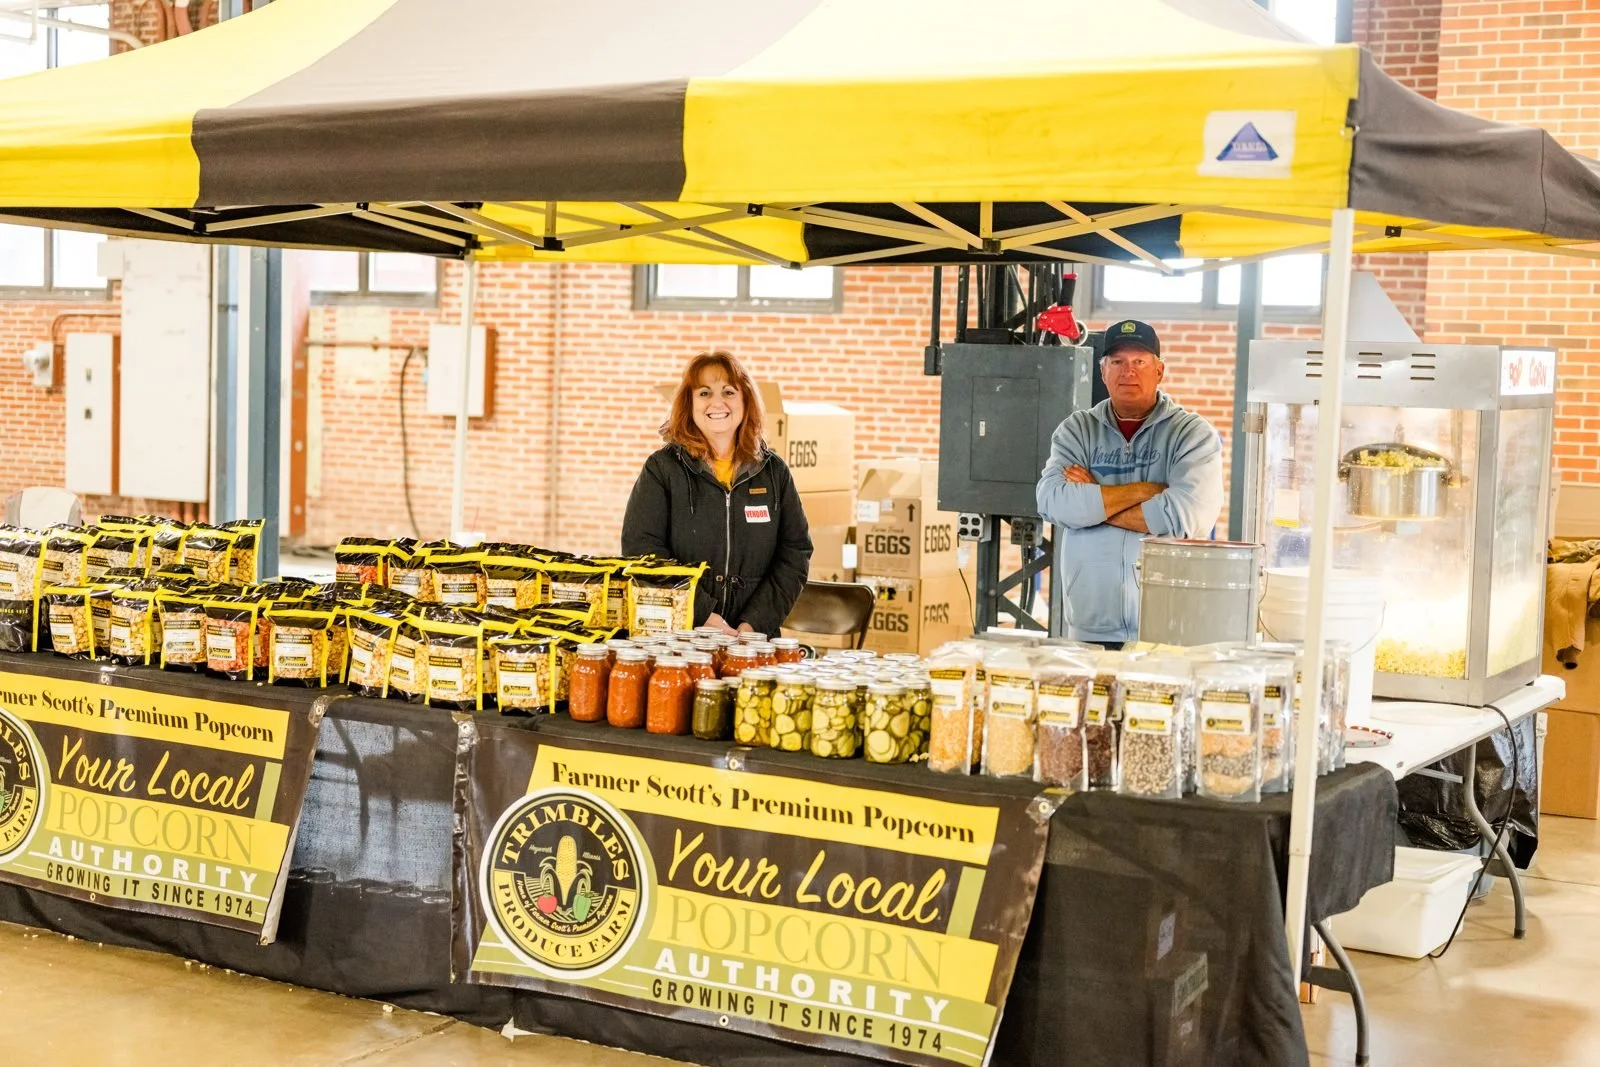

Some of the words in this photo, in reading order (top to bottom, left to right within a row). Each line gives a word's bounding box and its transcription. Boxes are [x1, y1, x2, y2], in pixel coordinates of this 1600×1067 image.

[789, 440, 818, 468] EGGS
[745, 510, 768, 518] VENDOR
[865, 534, 911, 556] EGGS
[924, 524, 952, 554] EGGS
[868, 612, 909, 633] GGS
[42, 689, 94, 716] Scott's
[99, 698, 188, 731] Premium
[194, 712, 274, 744] Popcorn
[58, 735, 136, 793] Your
[147, 750, 256, 810] Local
[552, 762, 642, 796] Farmer
[646, 780, 723, 809] Scott's
[731, 787, 855, 826] Premium
[863, 802, 976, 846] Popcorn
[4, 797, 34, 842] FARM
[58, 791, 254, 864] POPCORN
[502, 804, 629, 881] TRIMBLES
[47, 863, 112, 895] GROWING
[123, 877, 141, 897] IT
[151, 882, 206, 908] SINCE
[214, 894, 254, 919] 1974
[49, 837, 259, 894] AUTHORITY
[667, 828, 781, 901] Your
[796, 850, 943, 925] Local
[499, 883, 583, 958] PRODUCE
[588, 900, 631, 954] FARM
[669, 895, 945, 990] POPCORN
[652, 979, 756, 1022] GROWING
[769, 1000, 787, 1023] IT
[801, 1006, 875, 1040] SINCE
[888, 1022, 944, 1054] 1974
[654, 948, 950, 1025] AUTHORITY
